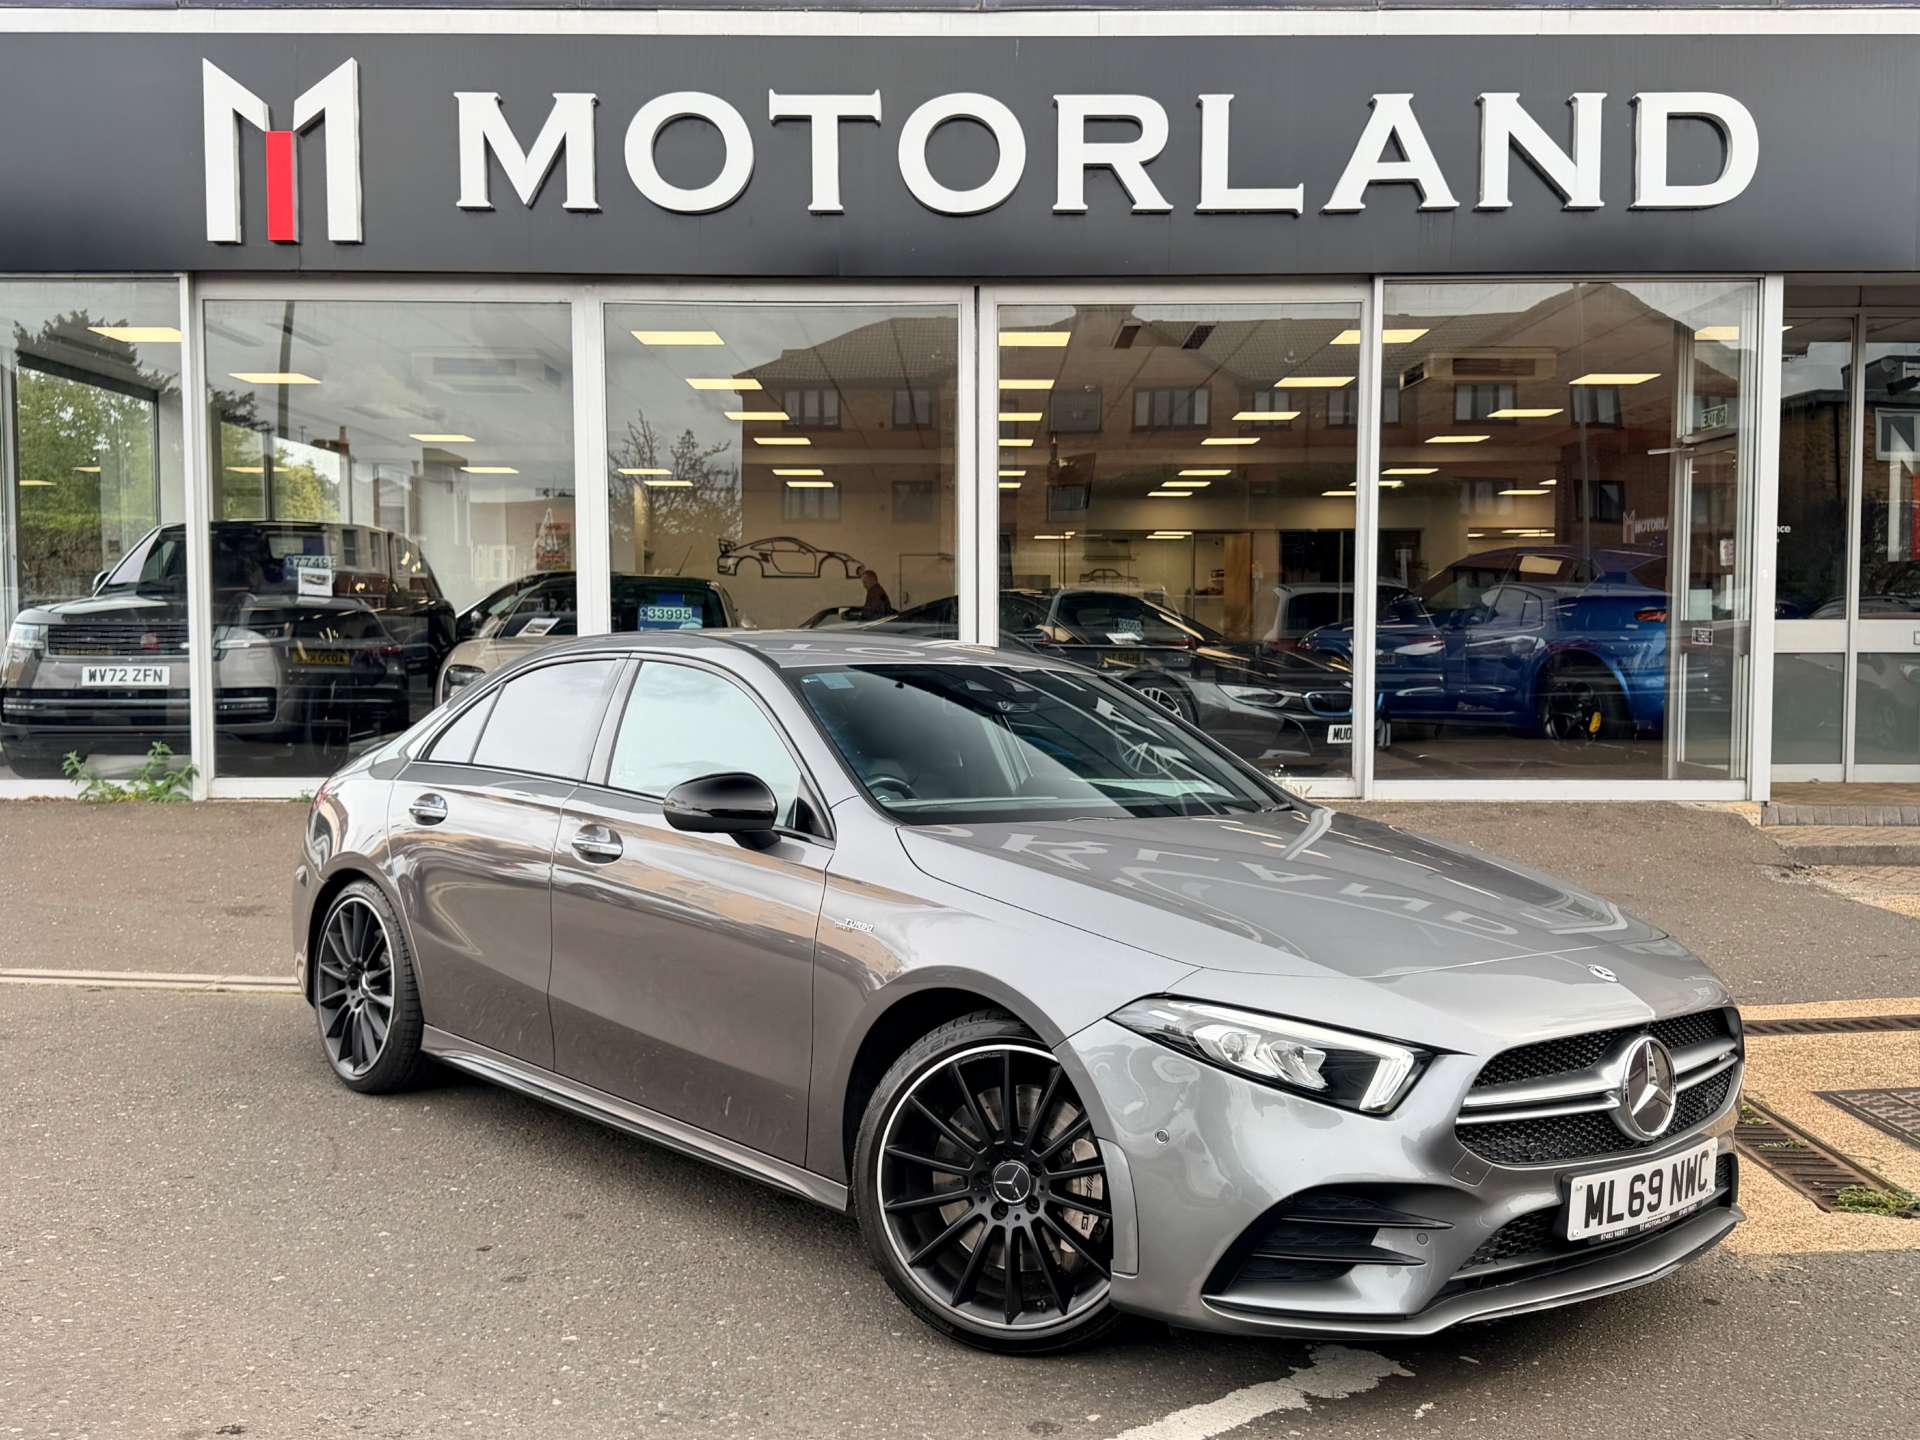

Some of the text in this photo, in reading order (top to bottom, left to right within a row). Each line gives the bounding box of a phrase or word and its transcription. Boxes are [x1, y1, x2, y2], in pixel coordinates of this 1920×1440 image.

[454, 90, 1761, 214] MOTORLAND
[88, 668, 163, 682] WV72 ZFN
[1584, 1150, 1709, 1229] ML69 NWC
